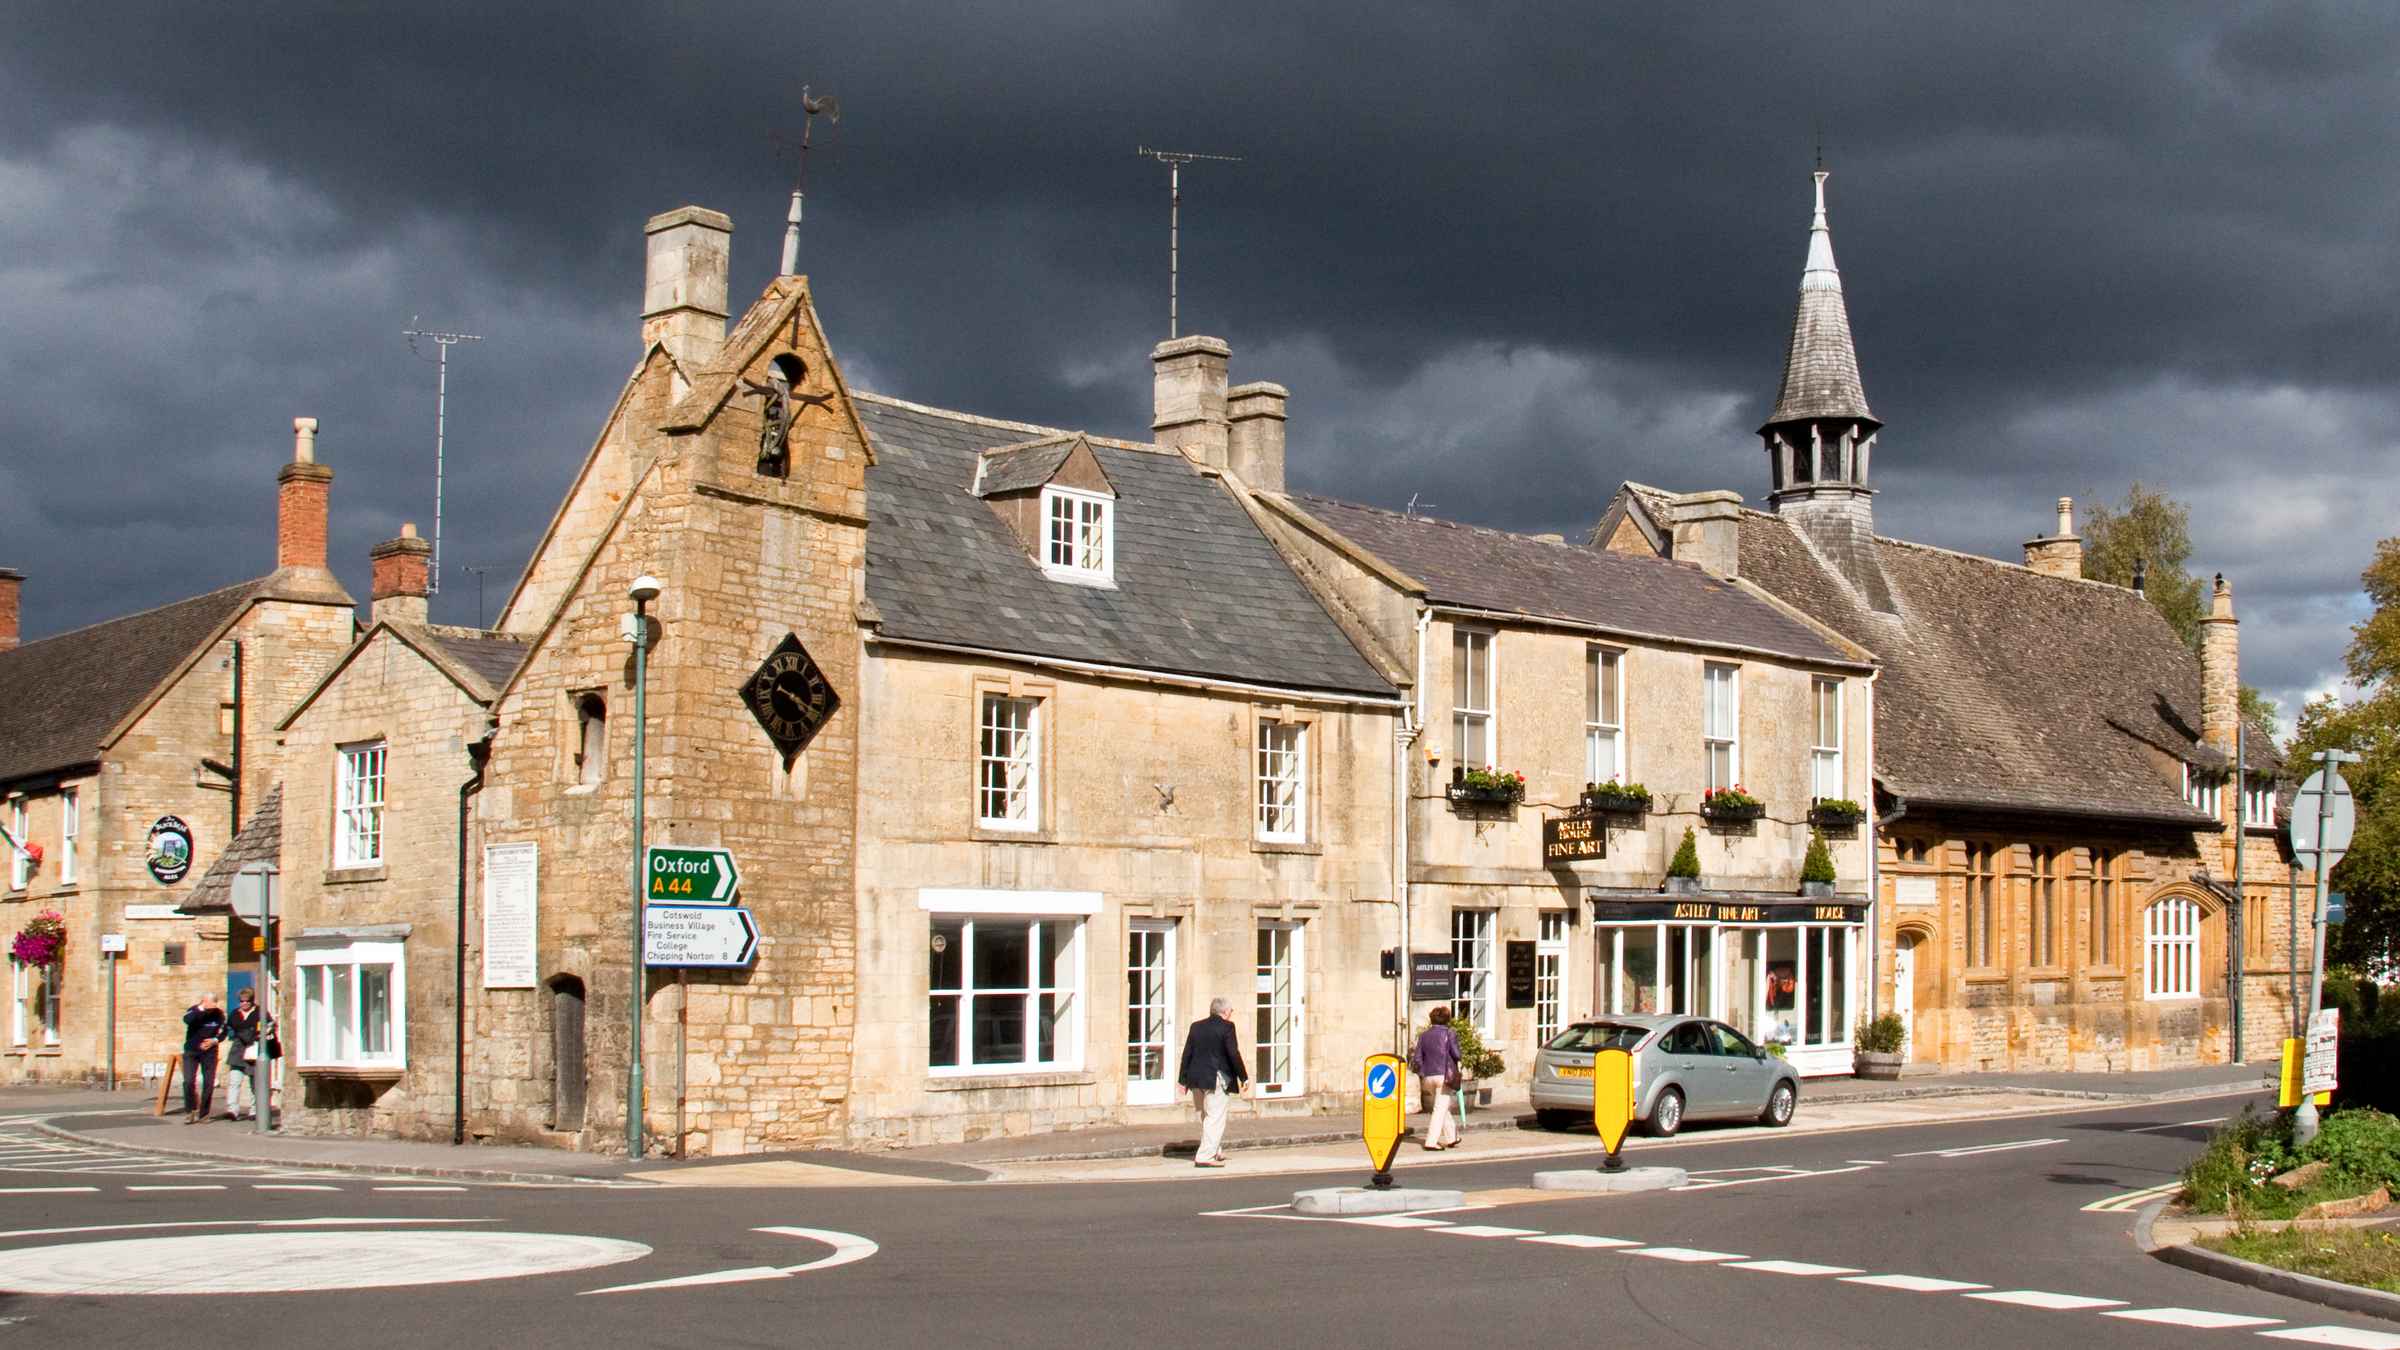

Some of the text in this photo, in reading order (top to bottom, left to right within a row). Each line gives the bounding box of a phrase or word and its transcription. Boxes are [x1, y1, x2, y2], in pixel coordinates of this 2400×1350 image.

[1558, 820, 1592, 831] ASTLEY
[1559, 830, 1591, 839] HOUSE
[1548, 840, 1603, 856] FINE ART
[653, 855, 710, 874] Oxford
[652, 877, 692, 894] A 44
[662, 910, 703, 920] Cotswold
[1674, 903, 1846, 920] ASTLEY FINE ART HOUSE
[647, 920, 716, 931] Business Village
[647, 931, 697, 940] Fire Service
[656, 941, 688, 951] College
[647, 952, 728, 961] Chipping Norton 8
